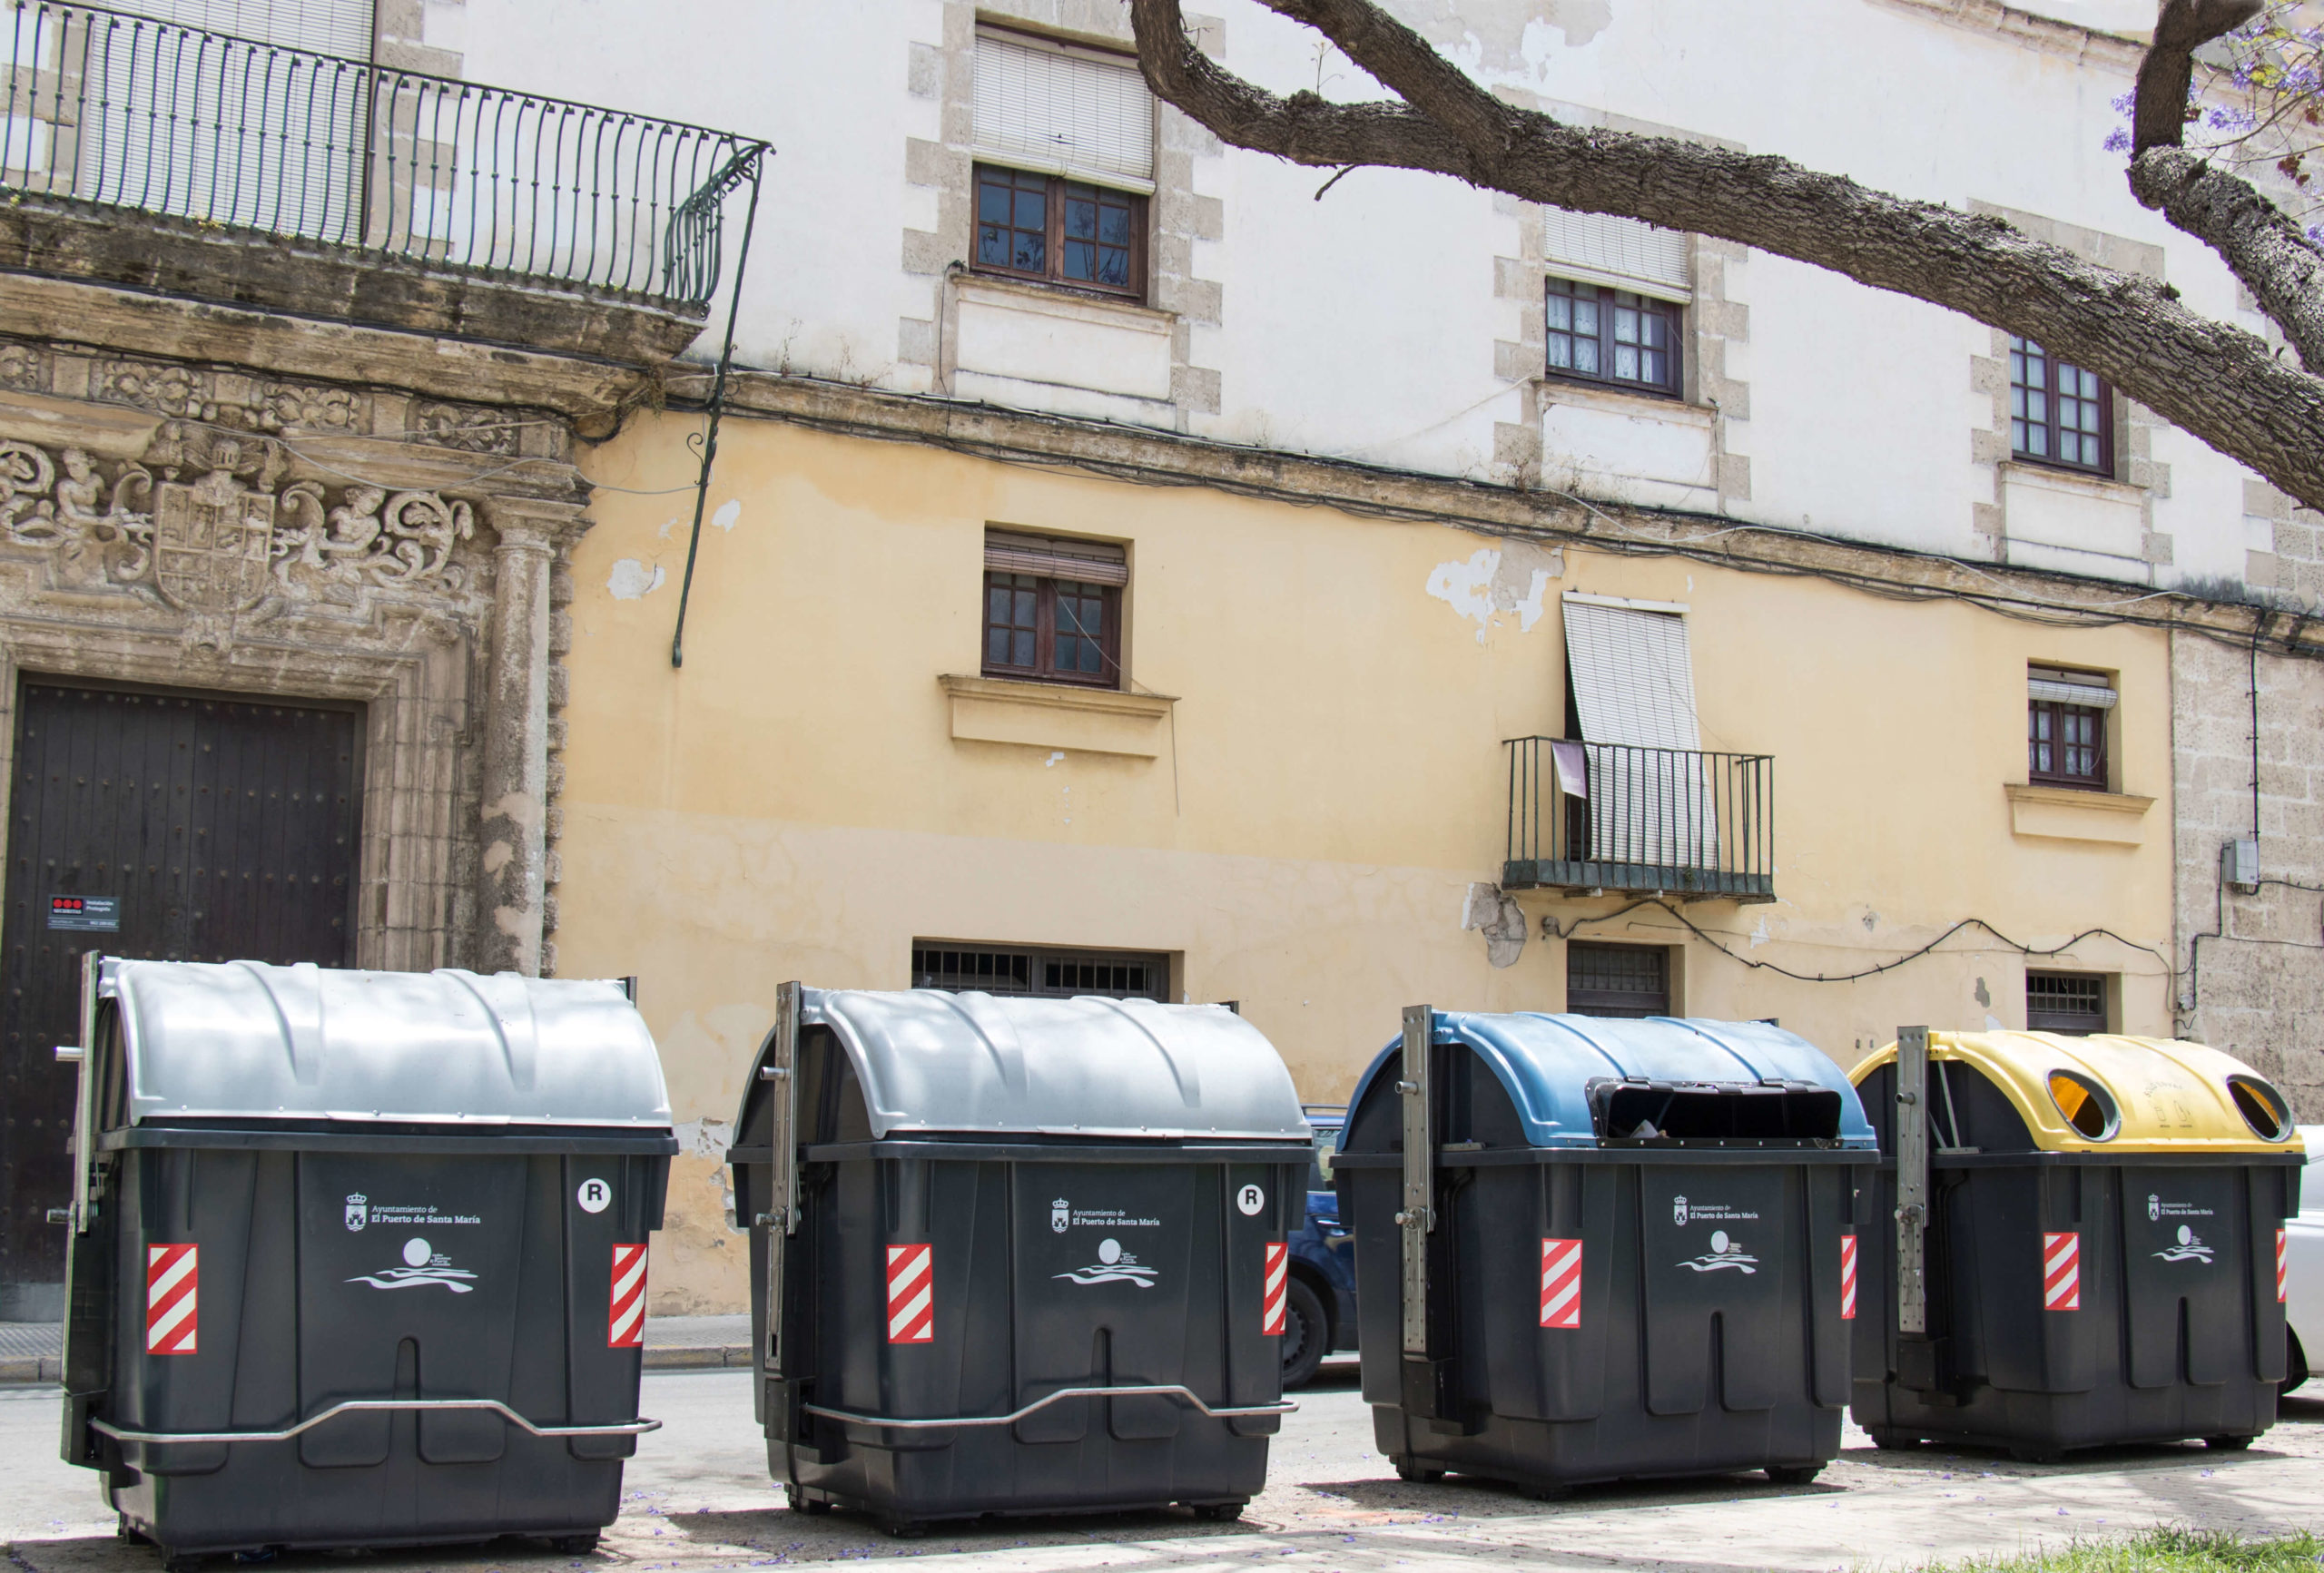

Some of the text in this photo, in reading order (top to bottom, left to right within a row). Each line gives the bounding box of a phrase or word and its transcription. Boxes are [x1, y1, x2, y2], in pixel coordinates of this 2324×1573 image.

[587, 1184, 603, 1201] R
[1245, 1189, 1257, 1204] R
[372, 1205, 427, 1214] Ayuntamiento
[427, 1215, 452, 1224] Santa
[455, 1215, 480, 1224] María
